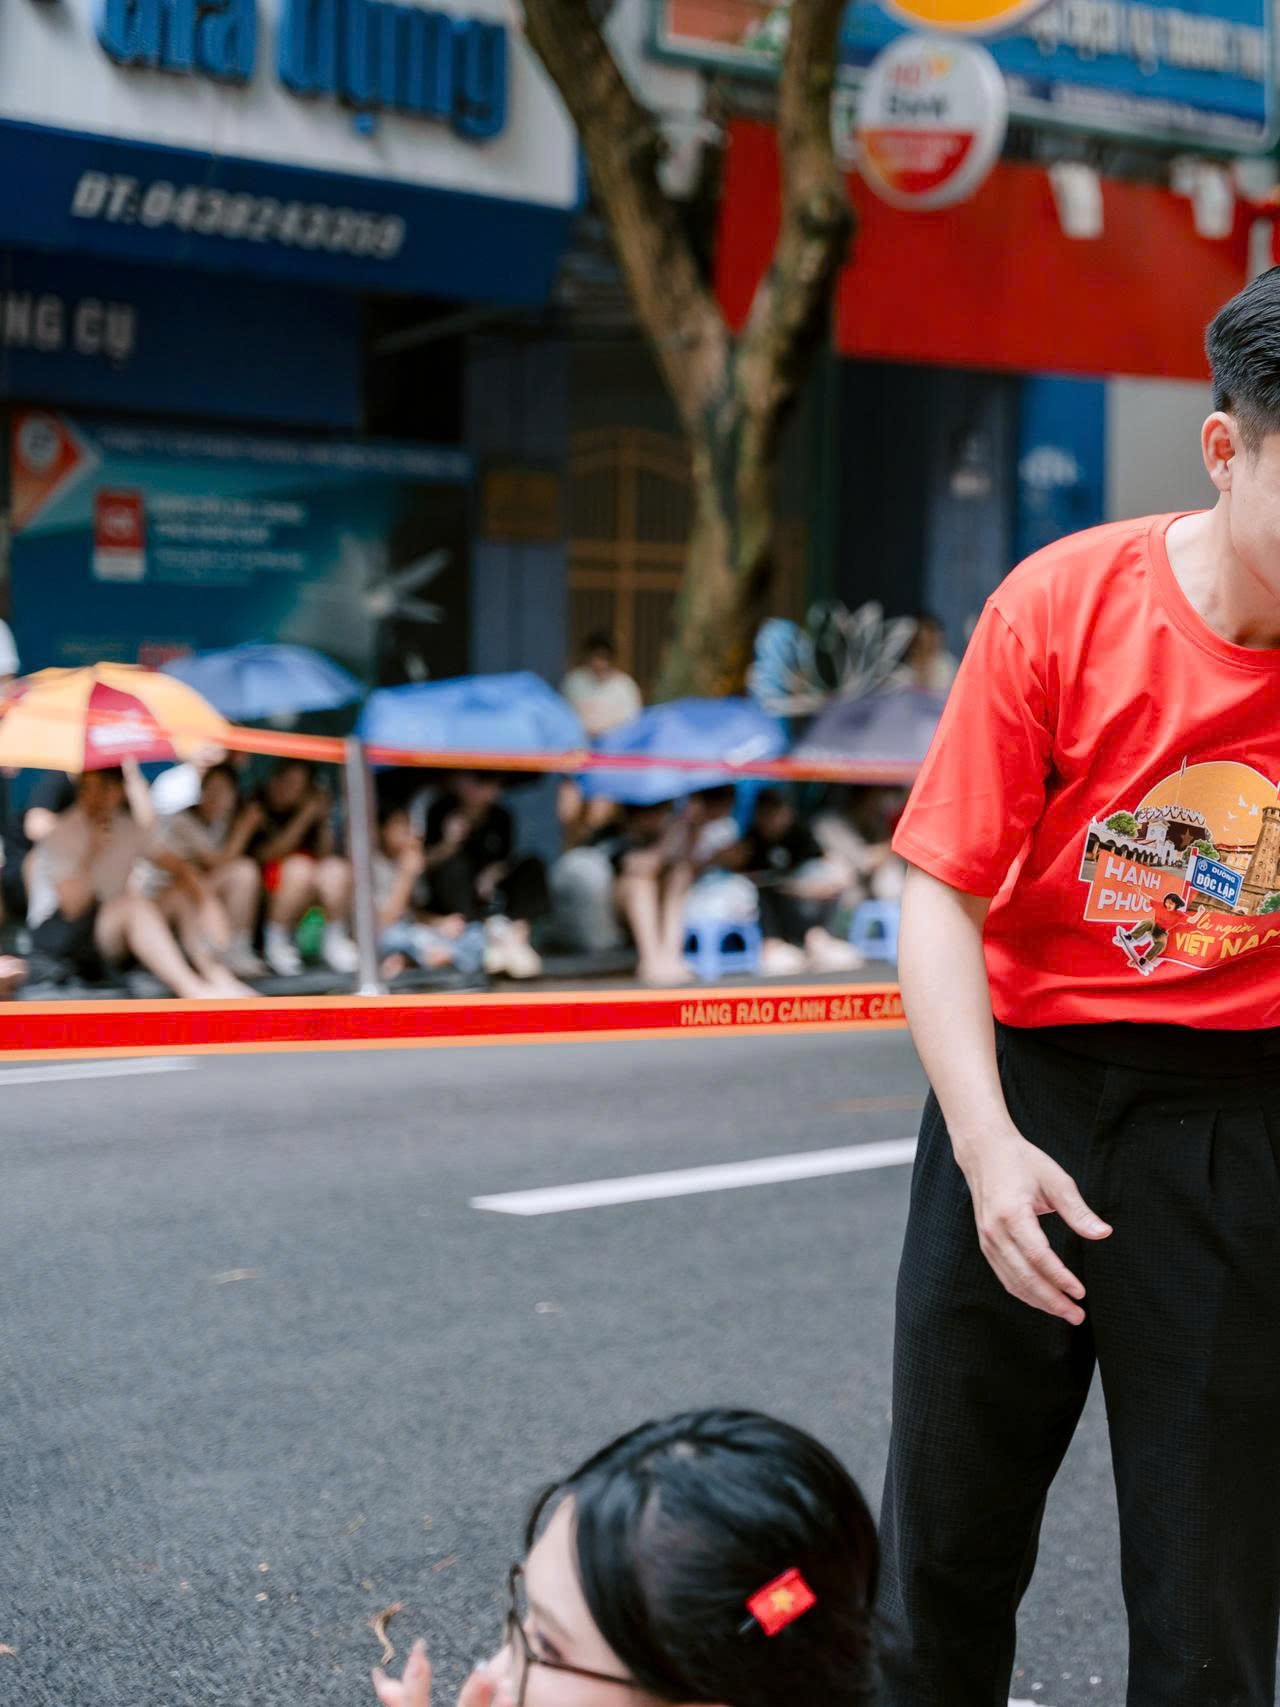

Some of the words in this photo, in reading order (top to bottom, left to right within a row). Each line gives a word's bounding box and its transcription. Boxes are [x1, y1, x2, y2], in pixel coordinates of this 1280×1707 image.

[1175, 930, 1215, 957] VIỆT
[680, 1000, 732, 1026] HÀNG
[736, 998, 775, 1024] RÀO
